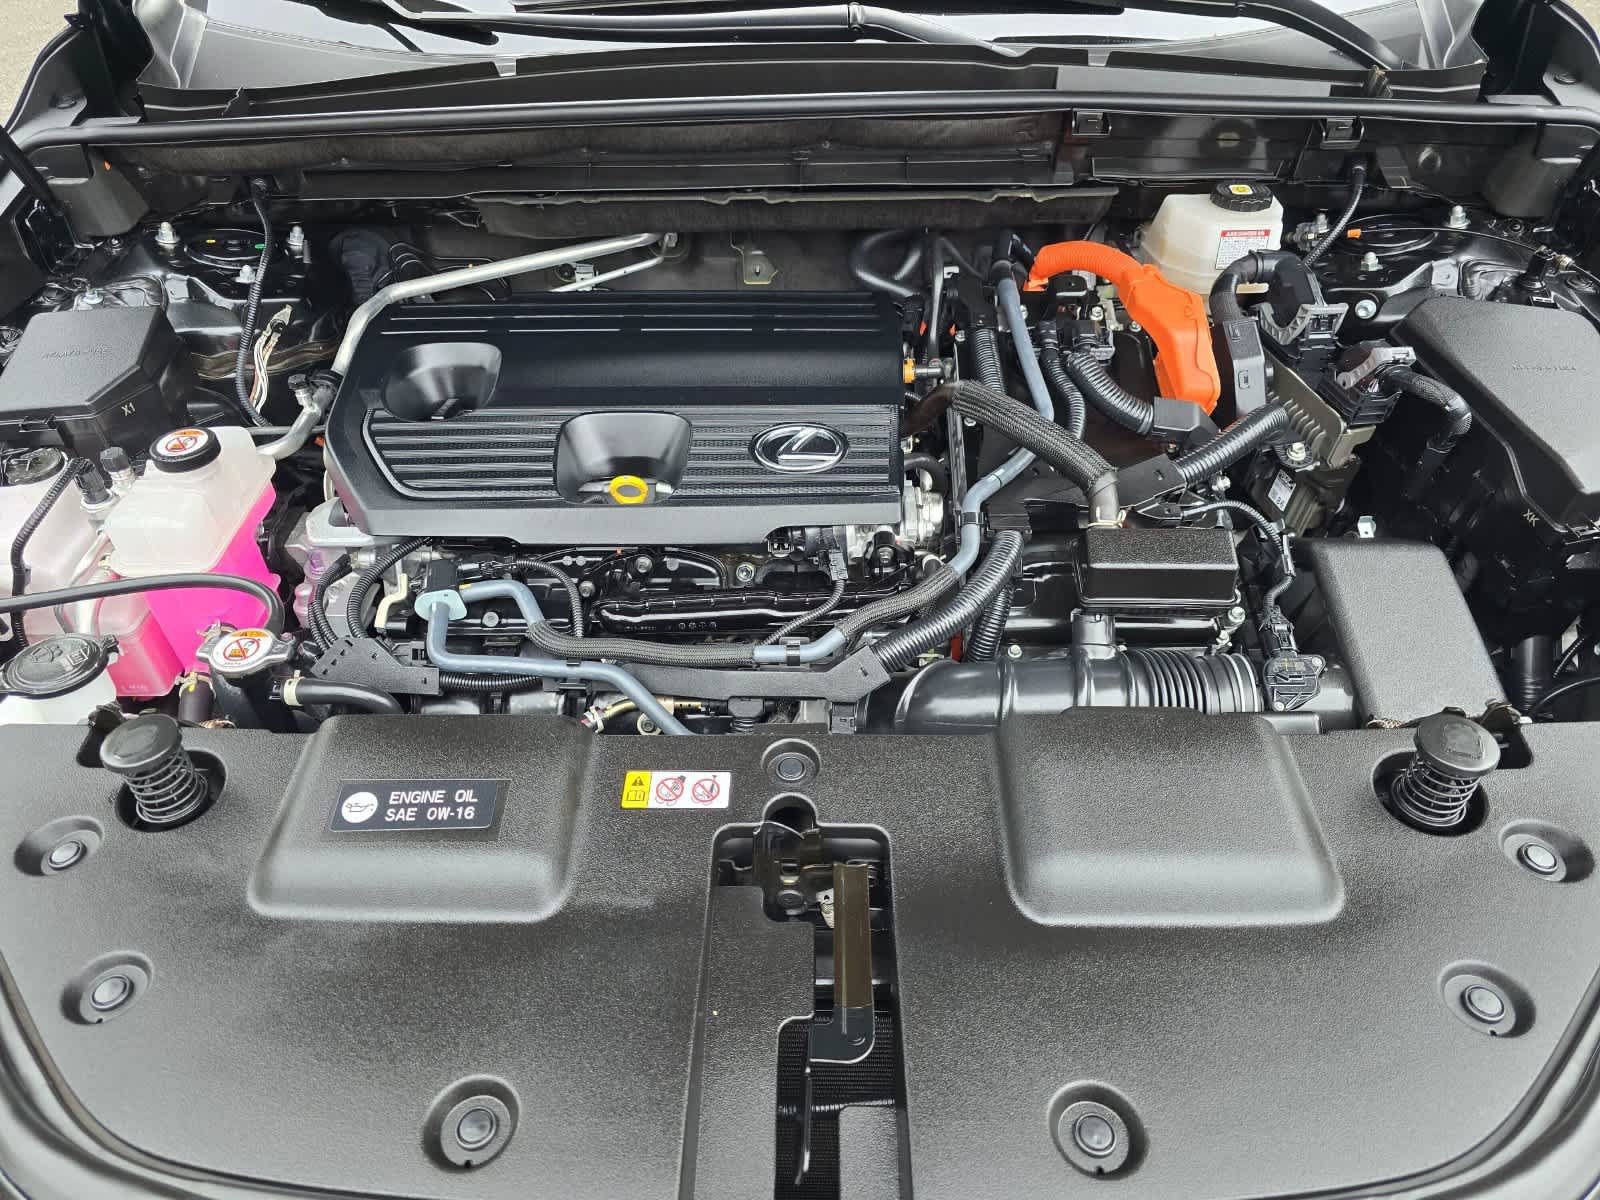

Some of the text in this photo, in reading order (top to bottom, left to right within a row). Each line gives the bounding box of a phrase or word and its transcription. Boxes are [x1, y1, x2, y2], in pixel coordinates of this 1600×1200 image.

[388, 789, 478, 805] ENGINE OIL
[384, 806, 476, 822] SAE 0W-16
